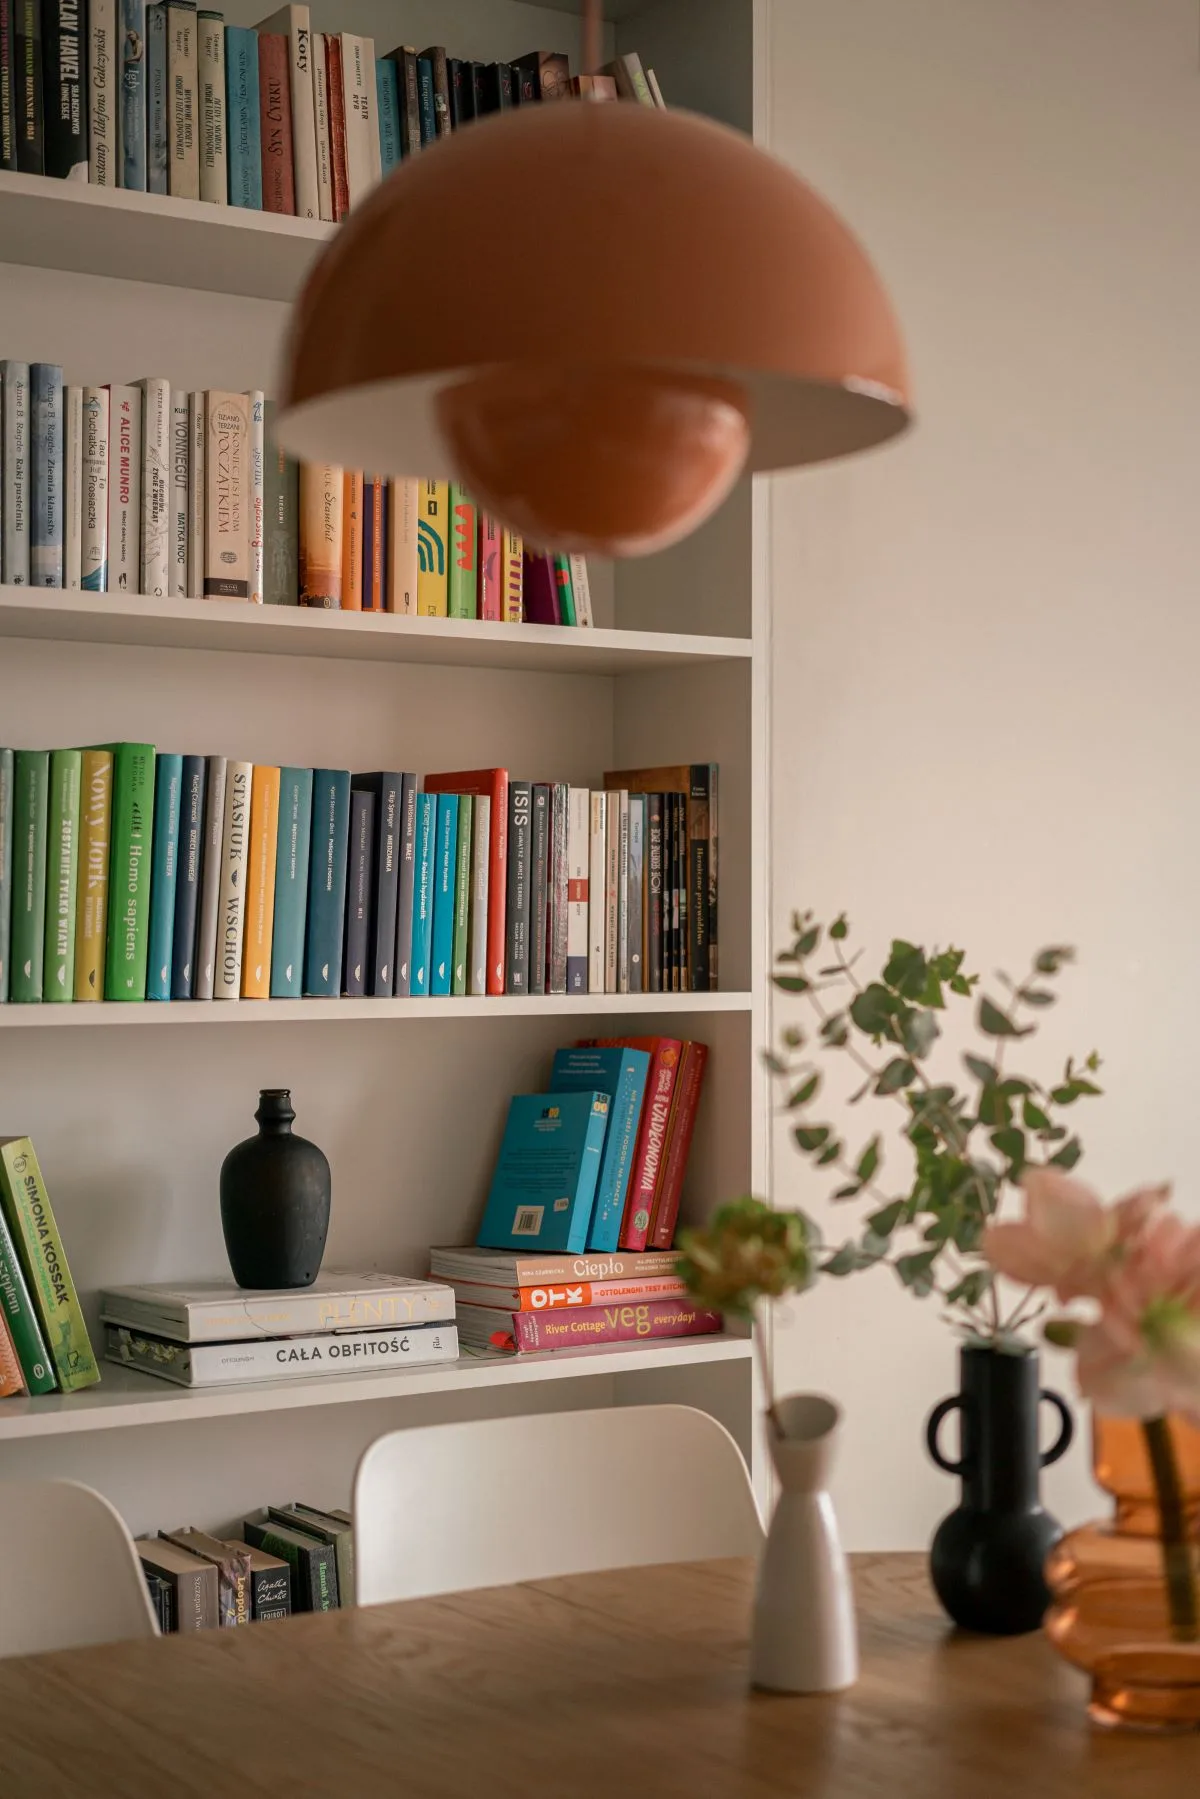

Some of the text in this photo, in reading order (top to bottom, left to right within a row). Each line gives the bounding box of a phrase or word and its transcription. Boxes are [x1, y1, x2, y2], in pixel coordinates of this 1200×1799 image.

[60, 35, 79, 81] HAVEL
[297, 28, 309, 72] Koty
[93, 27, 110, 138] Ildefons Gałczyński
[125, 68, 140, 90] Igły
[422, 75, 430, 112] Marquez
[266, 77, 282, 122] CYRKU
[361, 96, 369, 120] TEATR
[268, 128, 283, 156] SYN
[89, 410, 98, 456] Puchatka
[217, 413, 241, 422] TIZIANO
[14, 381, 25, 532] Anne B. Ragde Raki pustelniki
[45, 383, 56, 536] Anne B. Ragde Ziemia kłamstw
[99, 440, 107, 457] Tao
[120, 417, 130, 504] ALICE MUNRO
[175, 421, 187, 491] VONNEGUT
[99, 477, 106, 490] Te
[216, 431, 231, 534] POCZĄTKIEM
[231, 431, 240, 533] KONIEC JEST MOIM
[251, 447, 263, 547] Buscaglia MIŁOŚĆ
[88, 475, 98, 529] Prosiaczka
[151, 488, 159, 524] ZWIERZĄT
[177, 512, 186, 564] MATKA NOC
[85, 762, 110, 889] Nowy Jork
[190, 794, 199, 823] Czarnecki
[387, 804, 395, 829] Springer
[514, 790, 529, 826] ISIS
[60, 819, 73, 874] ZOSTANIE
[222, 773, 247, 985] STASIUK WSCHÓD
[651, 871, 661, 894] MOJE
[696, 847, 704, 891] Heroiczne
[58, 878, 70, 914] TYLKO
[123, 845, 142, 961] Homo sapiens
[56, 919, 68, 956] WIATR
[628, 1104, 636, 1116] MA
[630, 1090, 638, 1103] NIE
[619, 1135, 630, 1165] POGODY
[640, 1103, 669, 1192] JADŁONOMIA
[617, 1168, 624, 1179] NA
[613, 1180, 621, 1206] SPACER
[23, 1175, 69, 1306] SIMONA KOSSAK
[573, 1258, 624, 1280] Ciepło
[531, 1287, 583, 1309] OTK
[600, 1287, 642, 1297] OTTOLENGHI
[319, 1297, 417, 1325] PLENTY
[545, 1324, 569, 1335] River
[571, 1321, 606, 1333] Cottage
[604, 1305, 652, 1335] veg
[653, 1311, 696, 1326] everyday!
[276, 1336, 411, 1363] CAŁA OBFITOŚĆ
[193, 1576, 202, 1614] Szczepan
[257, 1580, 287, 1592] Agatha
[257, 1590, 287, 1604] Christie
[319, 1562, 329, 1598] Hannah
[236, 1577, 246, 1624] Leopold
[264, 1611, 283, 1620] POIROT
